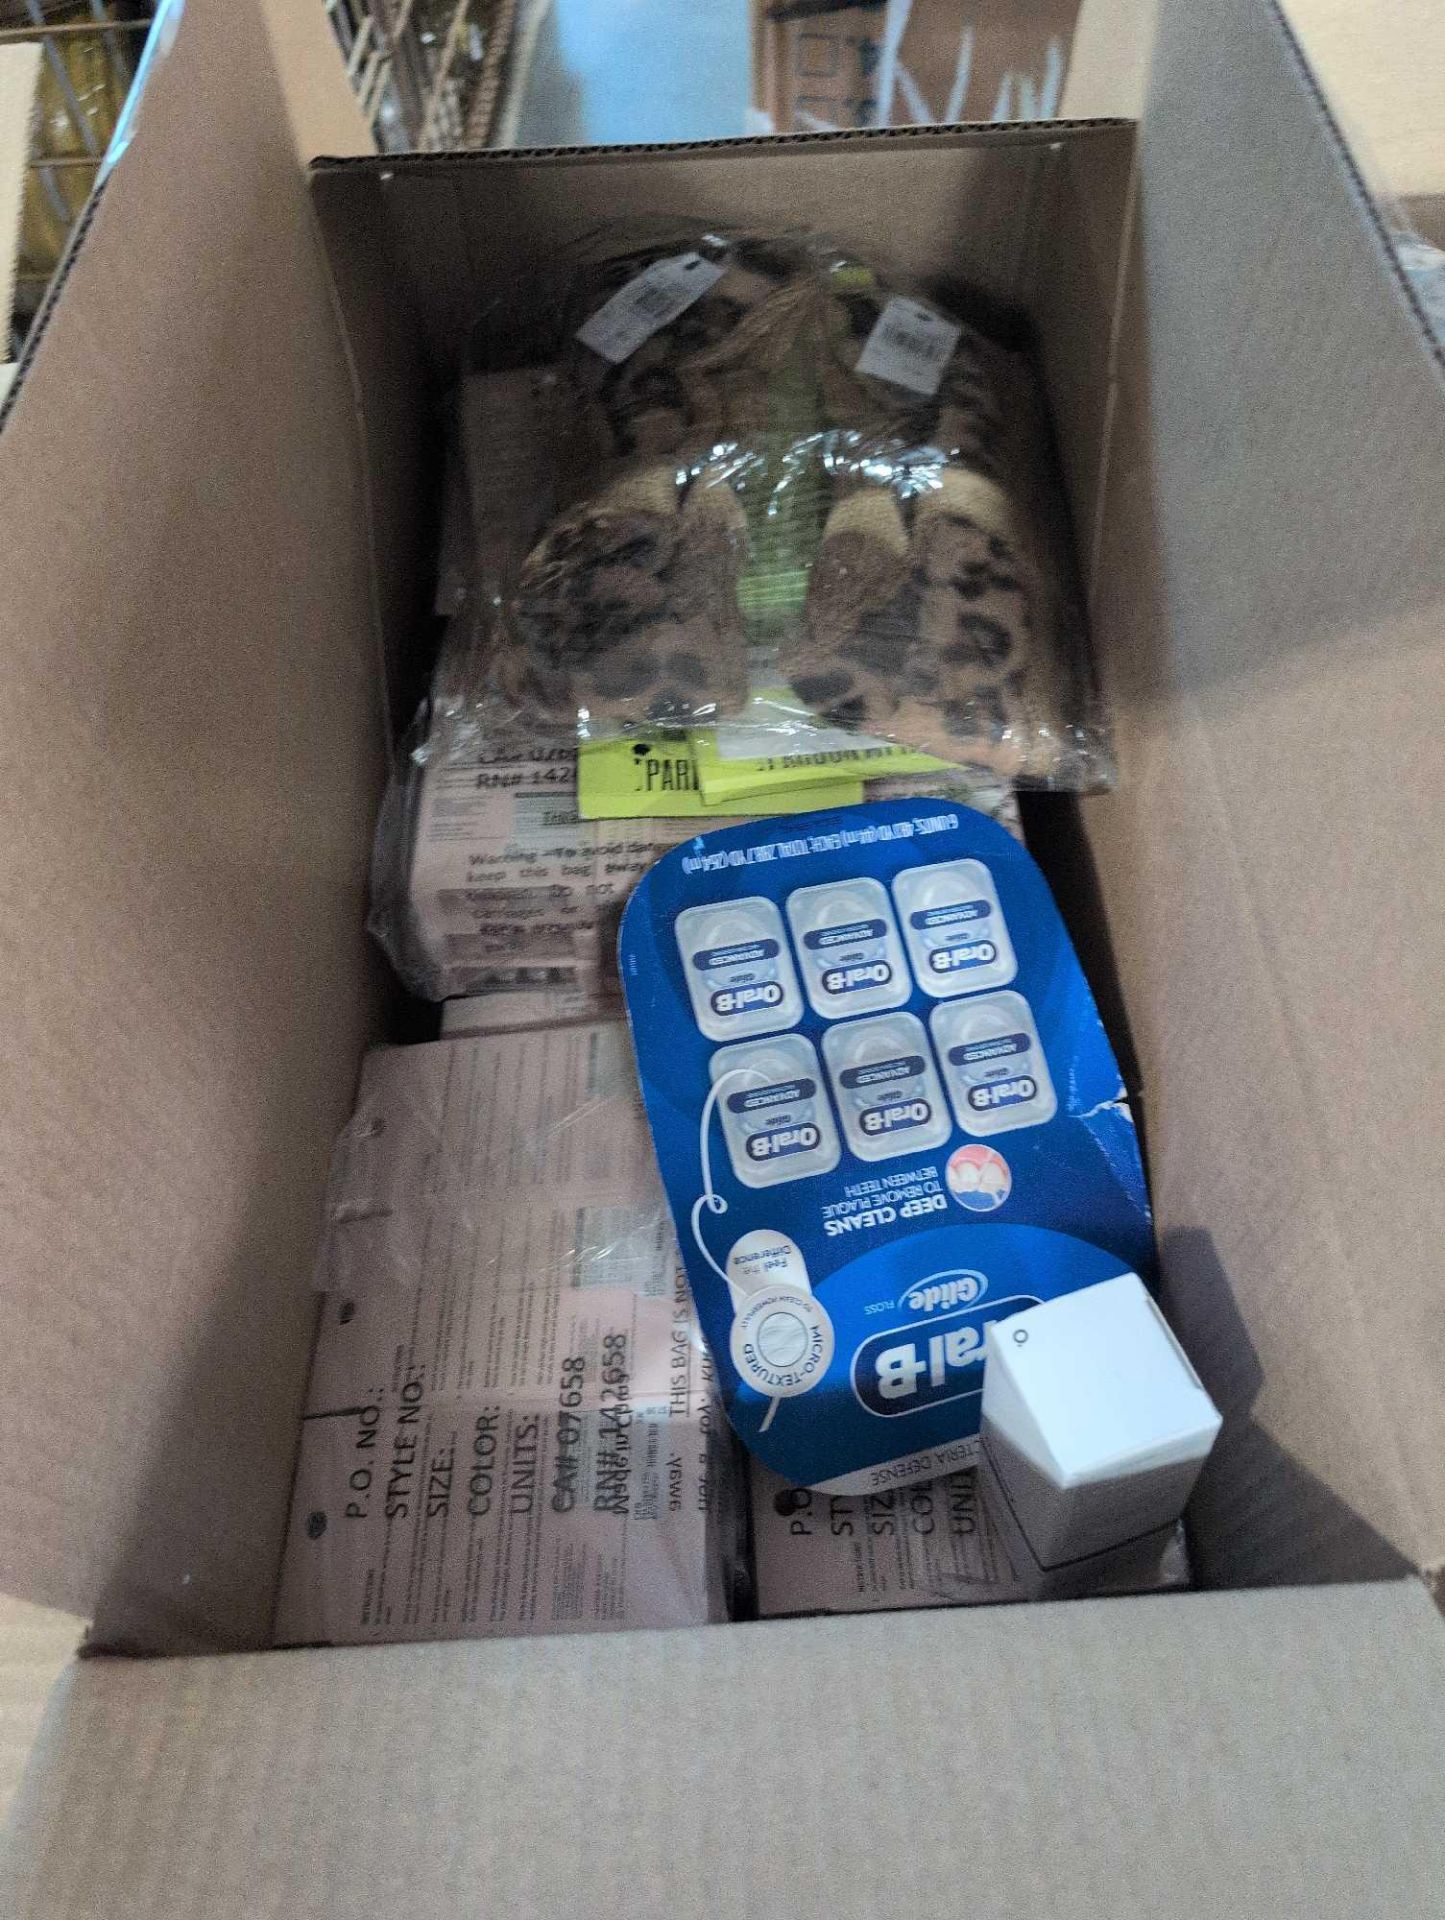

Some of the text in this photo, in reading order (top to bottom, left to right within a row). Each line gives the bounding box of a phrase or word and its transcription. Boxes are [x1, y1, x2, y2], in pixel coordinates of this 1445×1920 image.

[827, 964, 890, 989] Oral-B
[933, 945, 995, 970] Oral-B
[715, 985, 780, 1012] Oral-B
[972, 1080, 1034, 1106] Oral-B
[864, 1103, 930, 1131] Oral-B
[750, 1127, 817, 1157] Oral-B
[821, 1180, 943, 1219] TO REMOVE PLAQUE
[844, 1166, 938, 1197] BETWEEN TEETH
[824, 1194, 947, 1237] DEEP CLEANS
[864, 1277, 979, 1315] Glide FLOSS
[671, 1330, 689, 1369] BAG
[743, 1325, 824, 1387] MICRO-TEXTURED
[875, 1320, 997, 1399] ral-B
[556, 1357, 586, 1445] 07658
[669, 1374, 686, 1416] THIS
[344, 1388, 384, 1519] P.O. NO.:
[467, 1406, 500, 1516] COLOR:
[511, 1414, 539, 1514] UNITS:
[384, 1435, 417, 1518] STYLE
[427, 1448, 455, 1518] SIZE:
[790, 1488, 813, 1535] P.O
[871, 1490, 894, 1536] SIZ
[911, 1479, 935, 1535] COL
